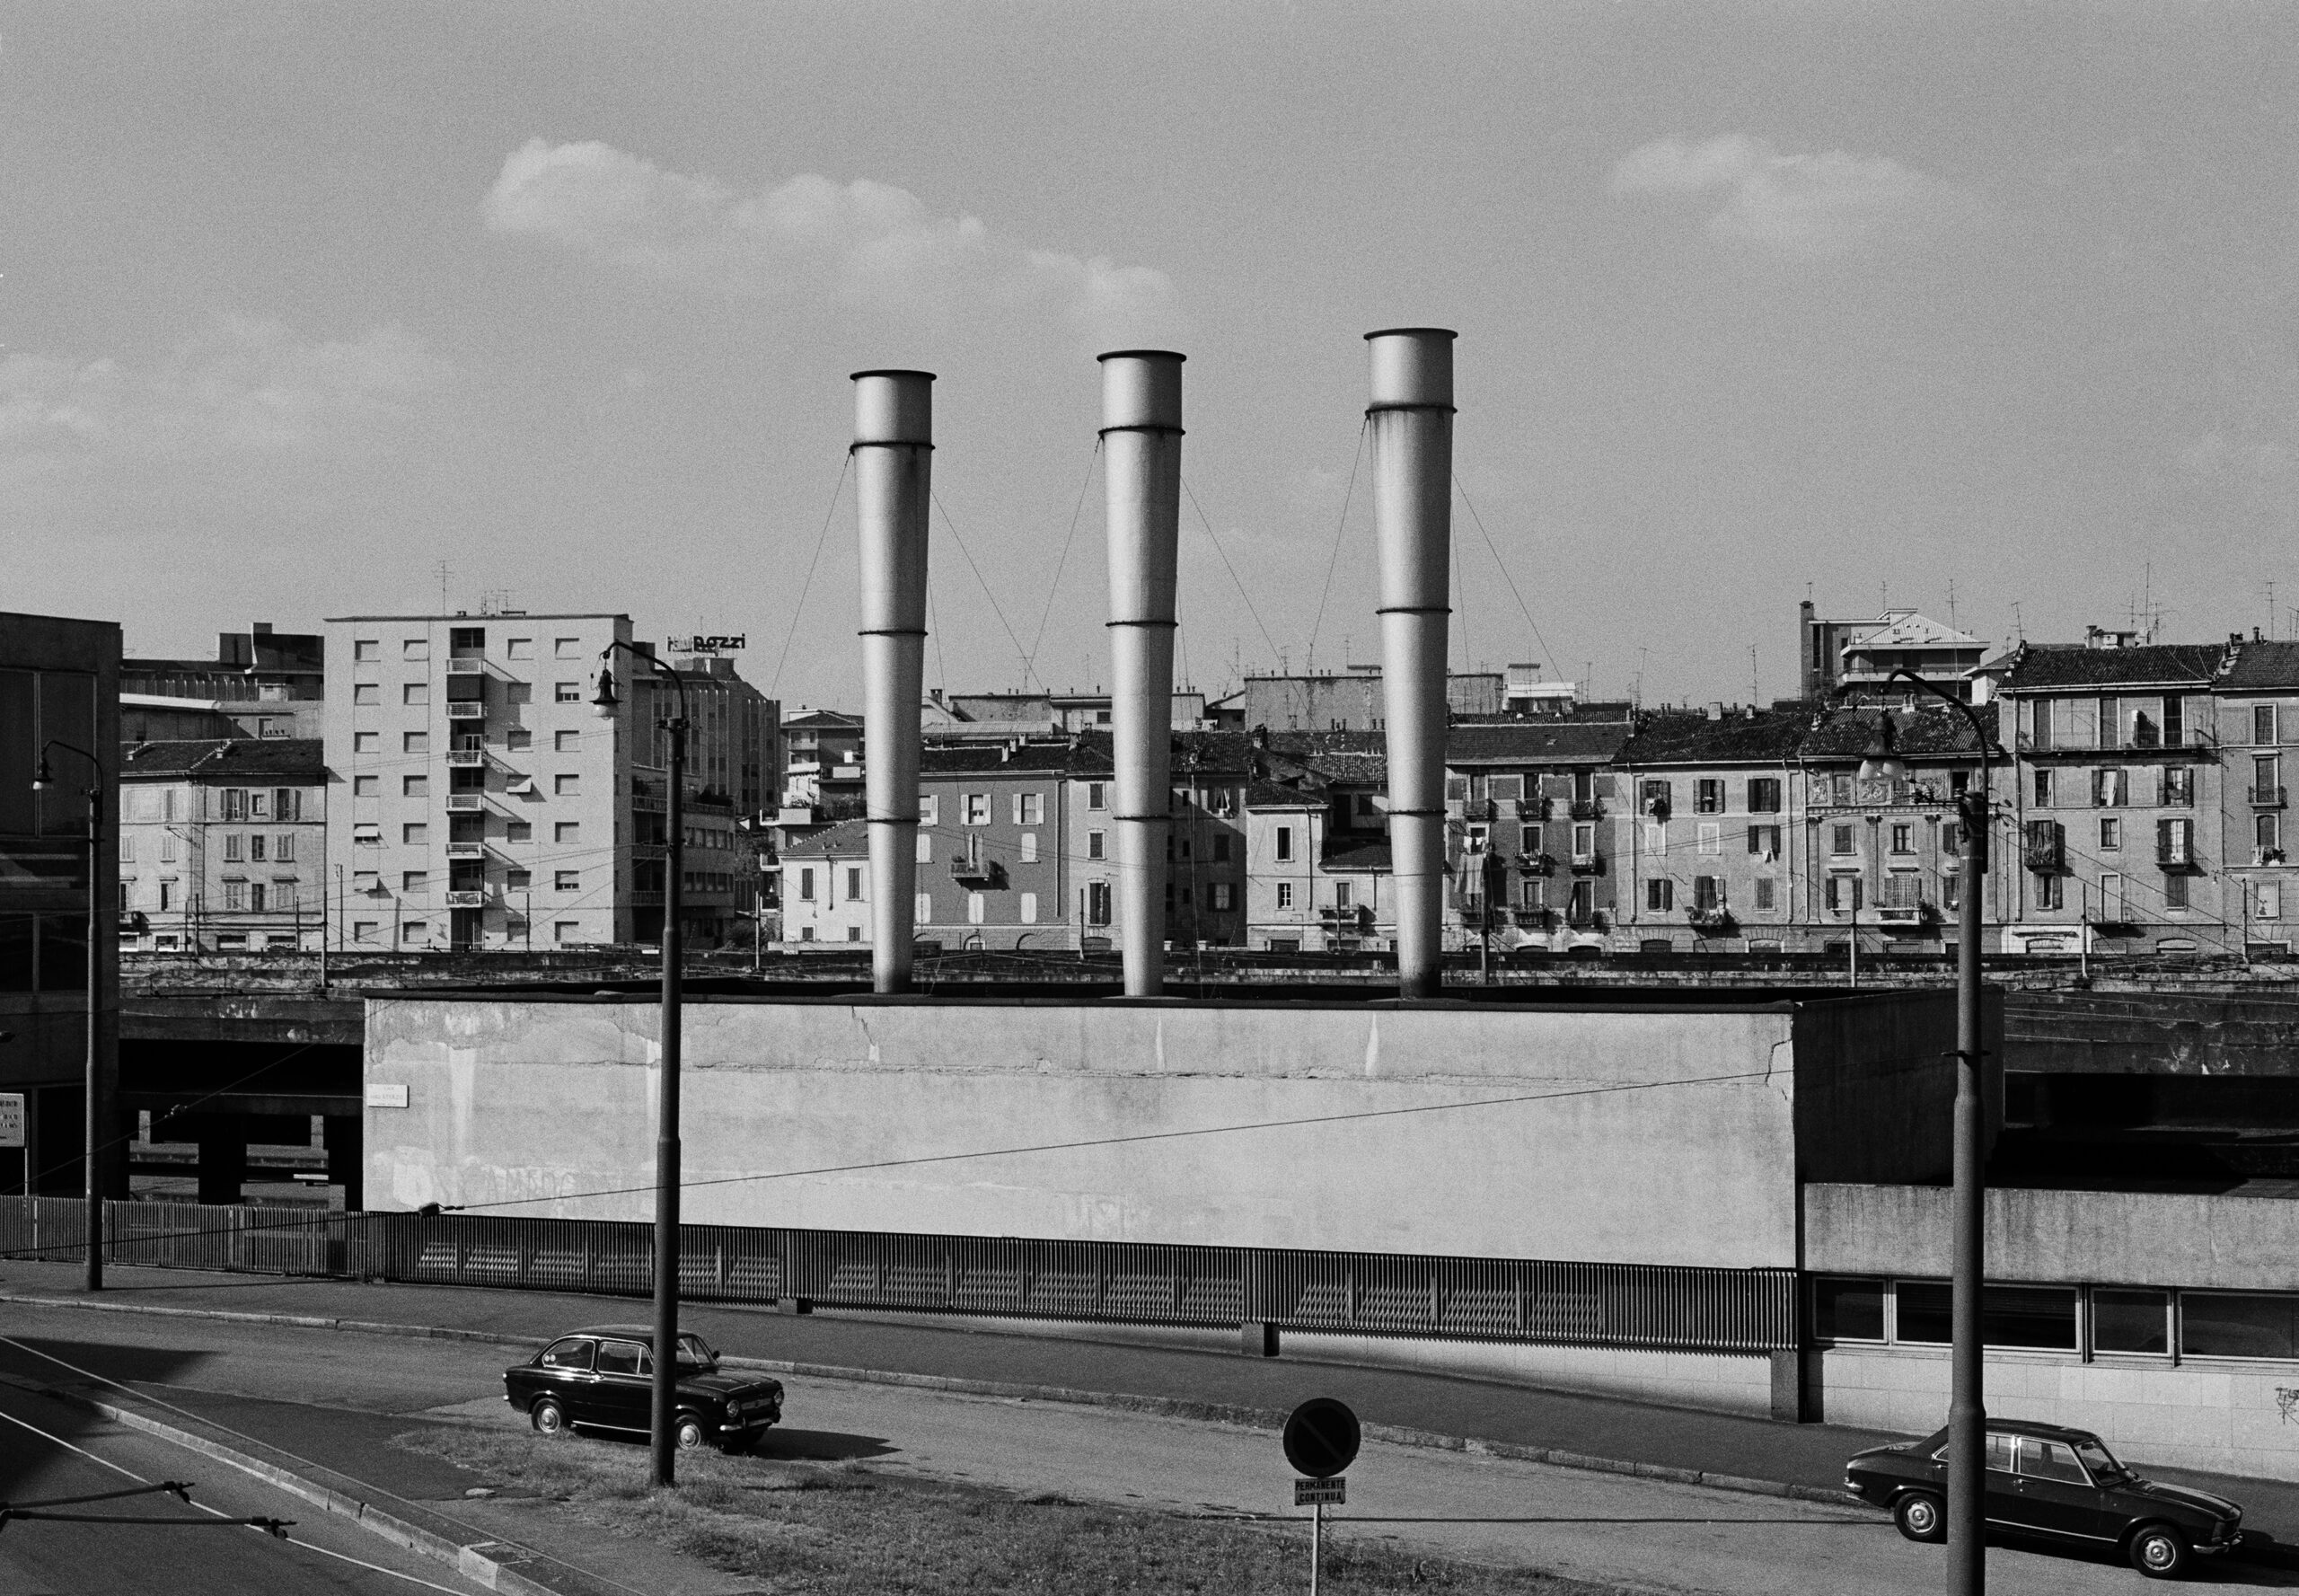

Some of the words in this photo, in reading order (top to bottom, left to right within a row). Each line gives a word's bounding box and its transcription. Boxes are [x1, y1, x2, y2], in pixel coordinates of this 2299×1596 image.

[693, 633, 745, 651] pozzi
[1295, 1479, 1345, 1491] PERMANENTE
[1299, 1492, 1342, 1503] CONTINUA
